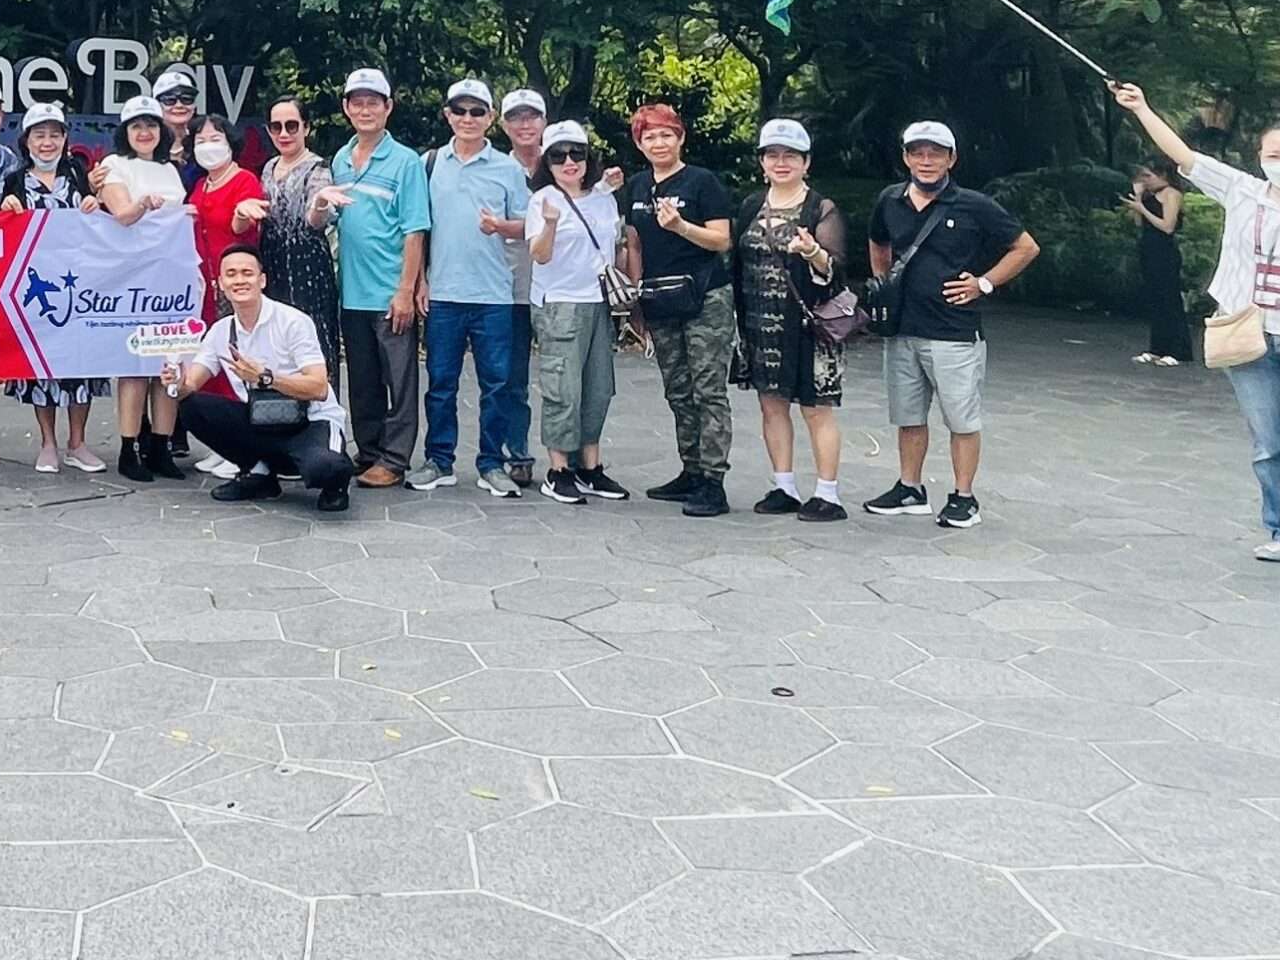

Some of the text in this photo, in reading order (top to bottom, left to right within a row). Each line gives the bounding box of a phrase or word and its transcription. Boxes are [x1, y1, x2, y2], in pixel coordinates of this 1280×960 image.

[74, 284, 196, 314] Star Travel
[154, 325, 187, 337] LOVE
